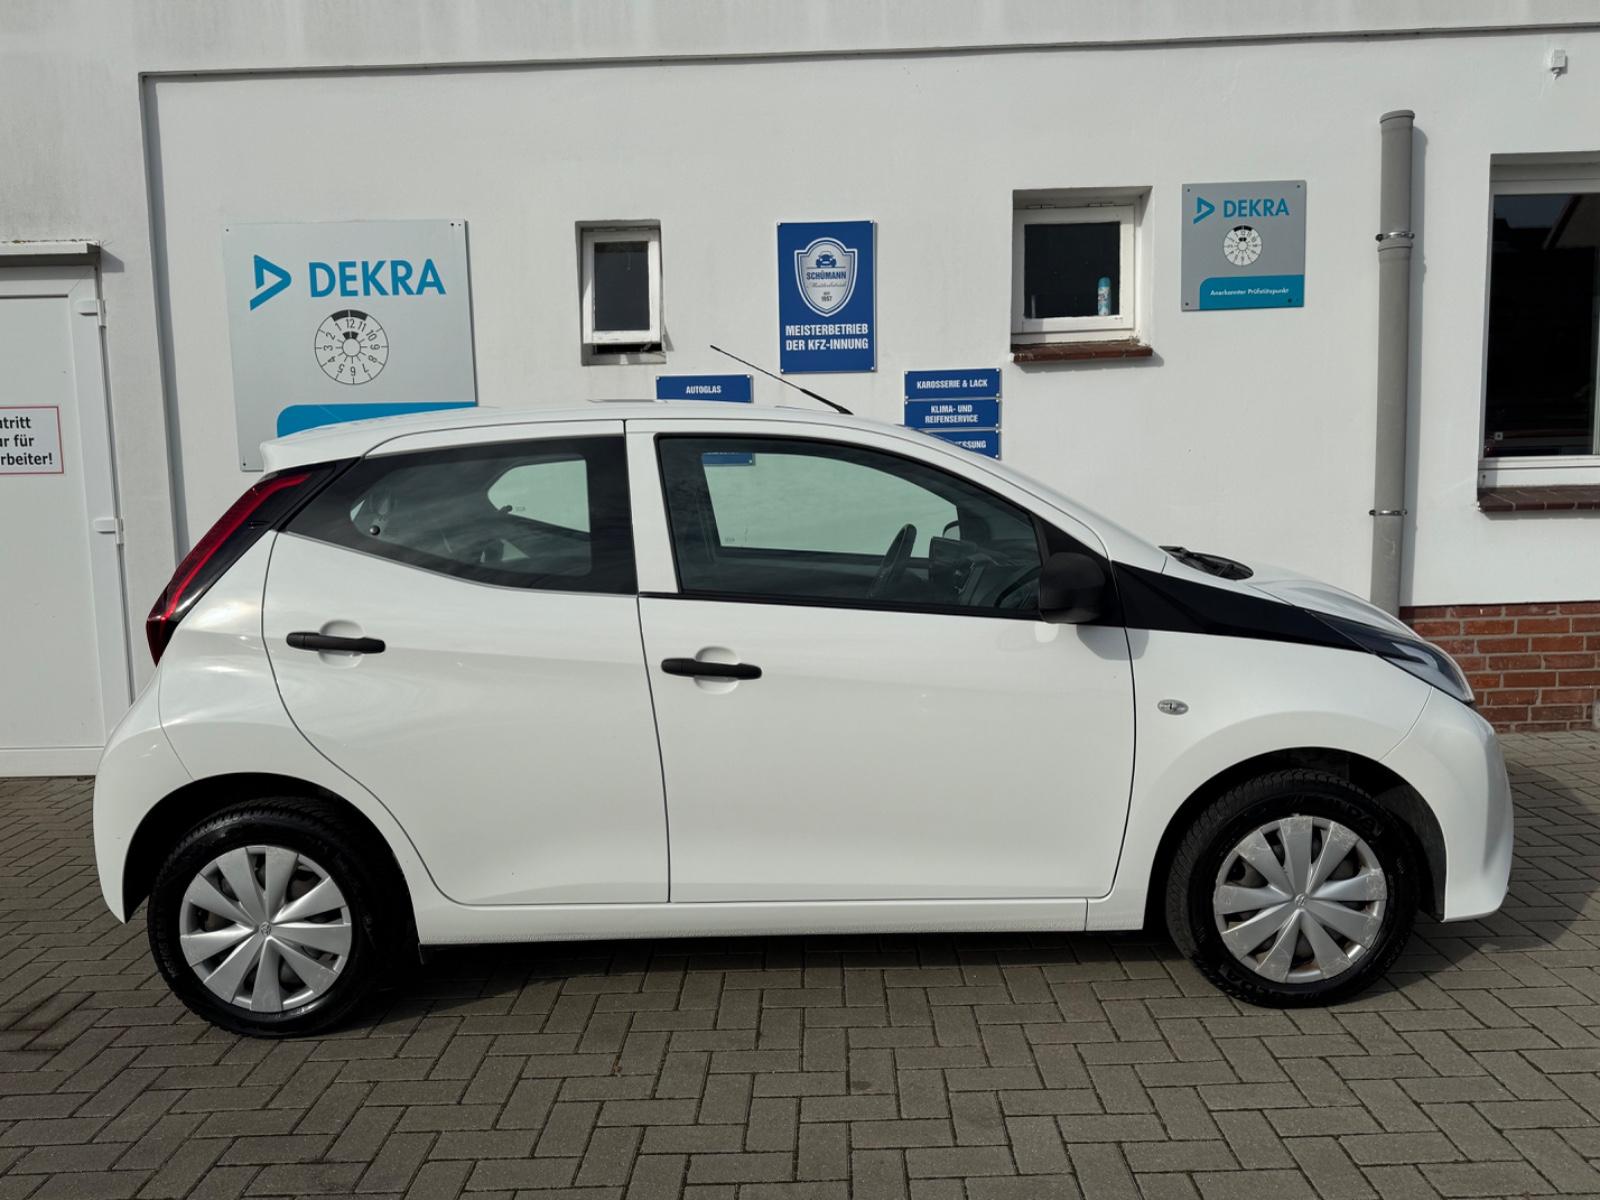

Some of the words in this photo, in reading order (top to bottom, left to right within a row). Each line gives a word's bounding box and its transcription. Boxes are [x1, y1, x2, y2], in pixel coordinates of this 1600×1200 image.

[1223, 197, 1290, 218] DEKRA
[308, 258, 447, 298] DEKRA
[806, 269, 847, 280] SCHÜMANN
[785, 323, 869, 337] MEISTERBETRIEB
[786, 340, 805, 351] DER
[808, 338, 869, 350] KFZ-INNUNG
[685, 385, 722, 394] AUTOGLAS
[916, 380, 960, 389] KAROSSERIE
[962, 379, 968, 388] &
[969, 379, 988, 388] LACK
[930, 405, 956, 414] KLIMA-
[957, 404, 973, 413] UND
[924, 414, 978, 424] REIFENSERVICE
[13, 434, 34, 447] für
